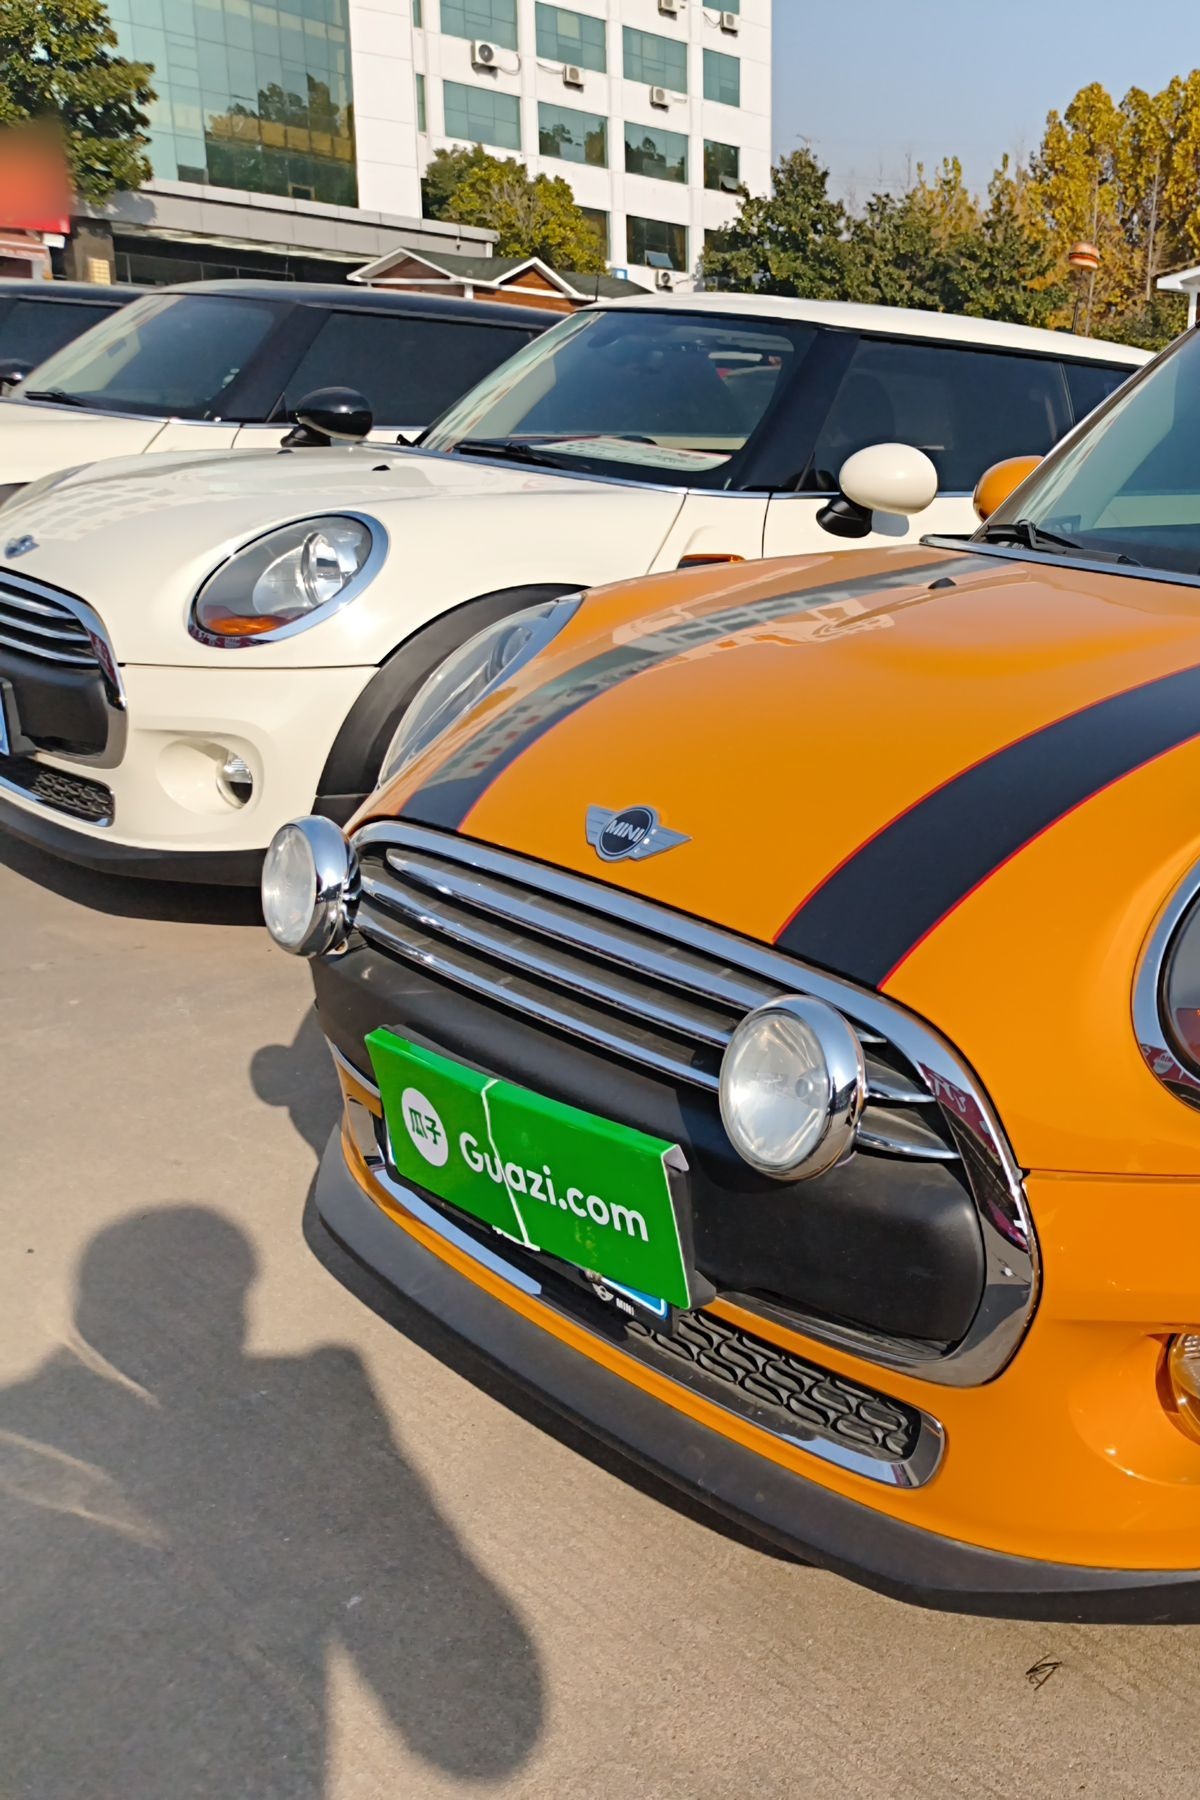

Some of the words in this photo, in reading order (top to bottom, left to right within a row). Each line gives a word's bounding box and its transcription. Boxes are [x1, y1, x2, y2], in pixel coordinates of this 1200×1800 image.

[605, 819, 645, 843] MINI
[408, 1106, 442, 1146] 瓜子
[459, 1131, 649, 1242] Guazi.com
[615, 1297, 635, 1316] MINI
